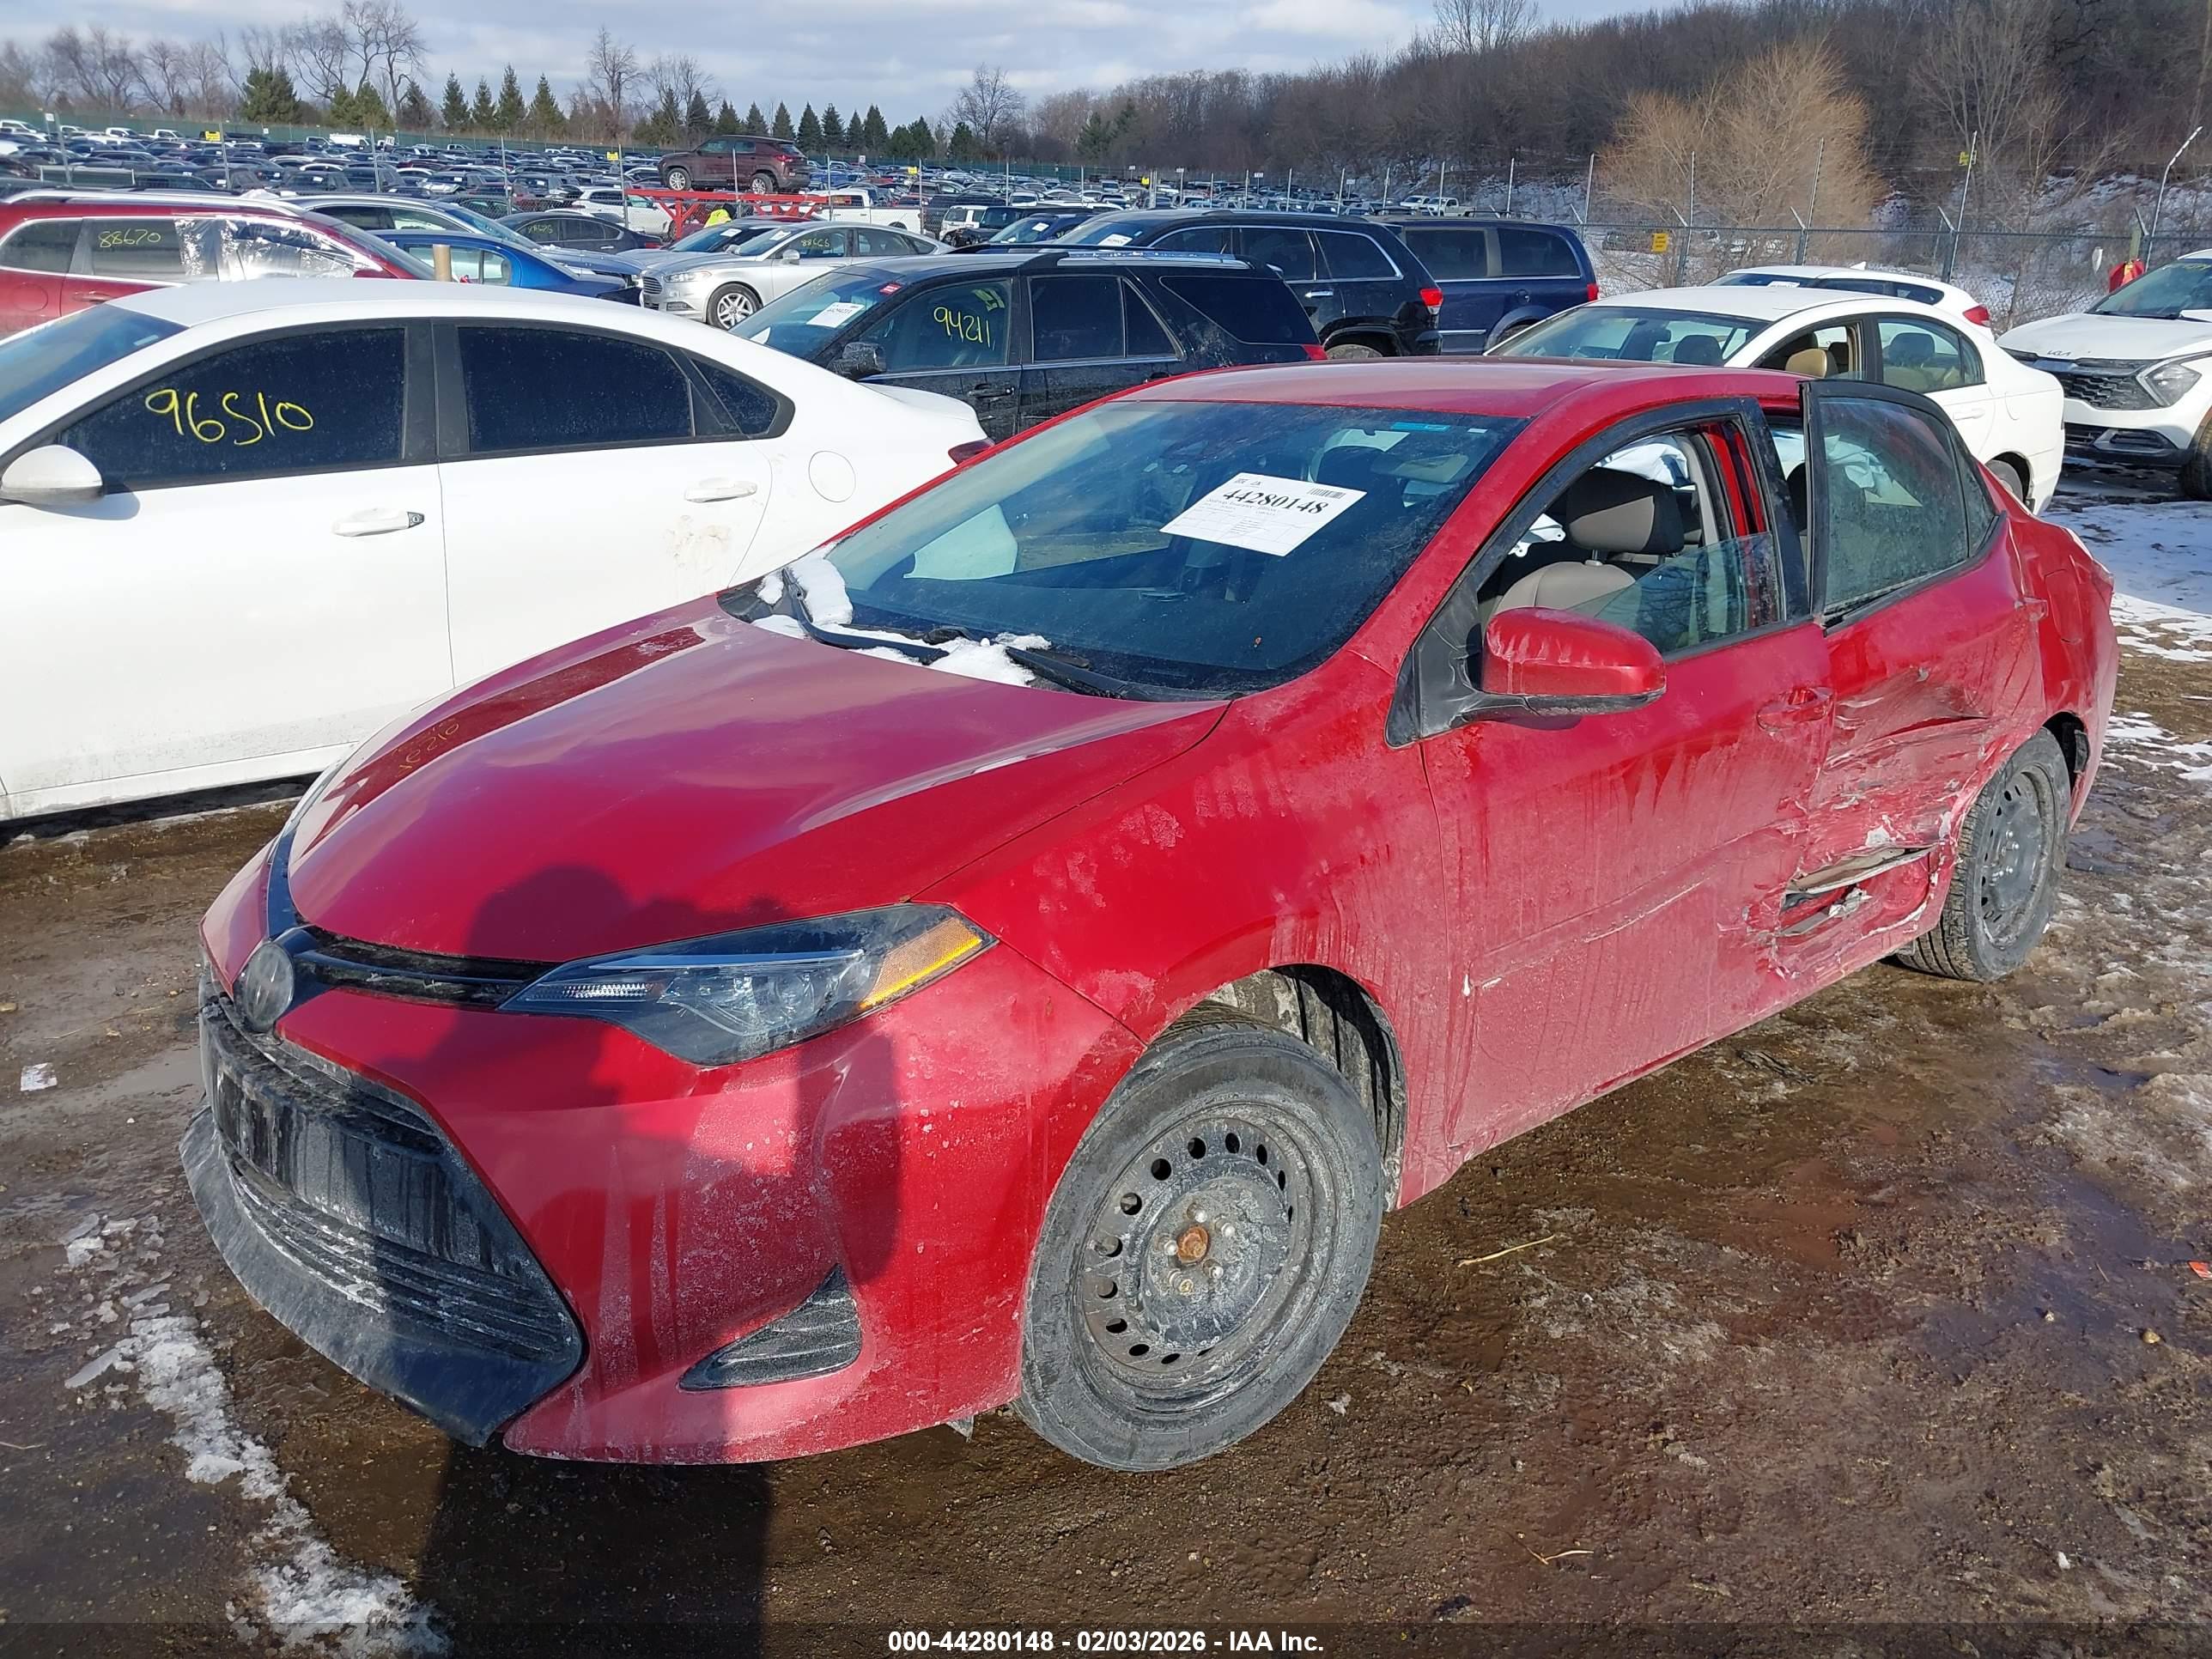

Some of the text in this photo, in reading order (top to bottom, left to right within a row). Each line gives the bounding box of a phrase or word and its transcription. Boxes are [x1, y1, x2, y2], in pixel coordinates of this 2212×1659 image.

[98, 228, 161, 247] 88670
[933, 307, 991, 349] 94211
[1223, 489, 1328, 514] 44280148
